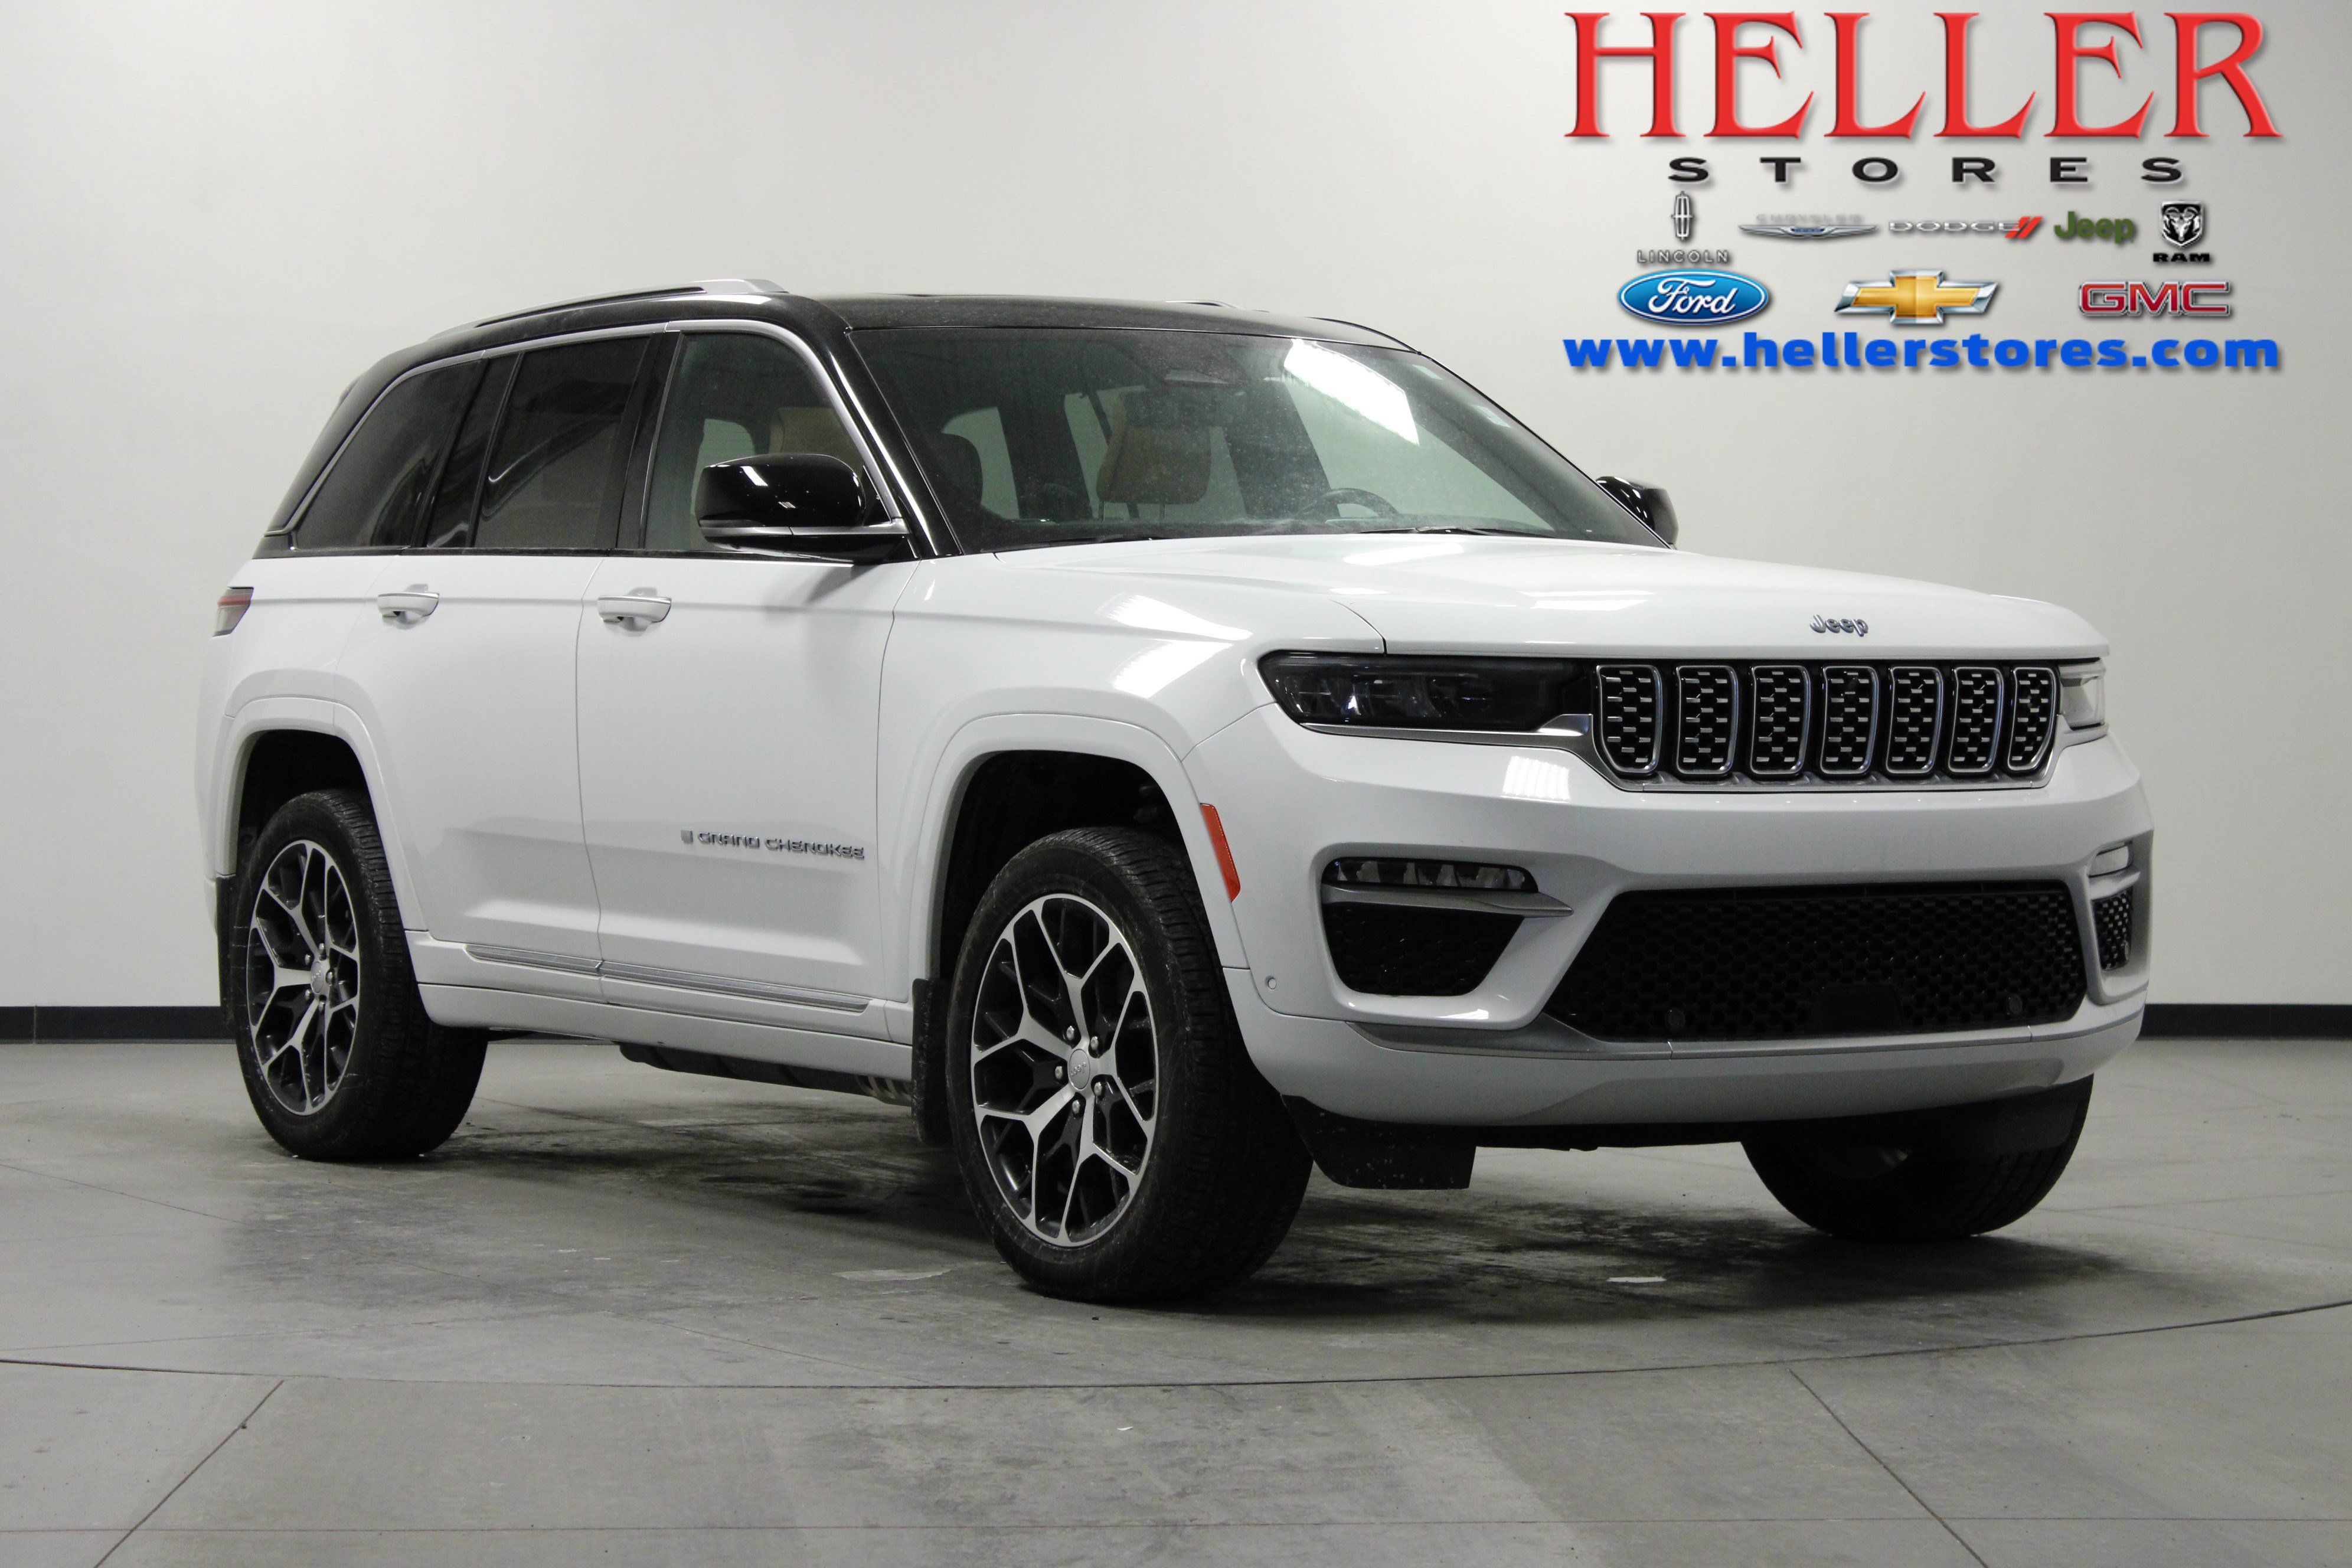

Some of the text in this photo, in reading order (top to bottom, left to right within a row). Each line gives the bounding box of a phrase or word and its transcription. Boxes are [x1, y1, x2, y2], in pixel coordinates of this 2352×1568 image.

[1809, 614, 1869, 638] Jeep
[698, 831, 865, 860] GRAND CHEROKEE
